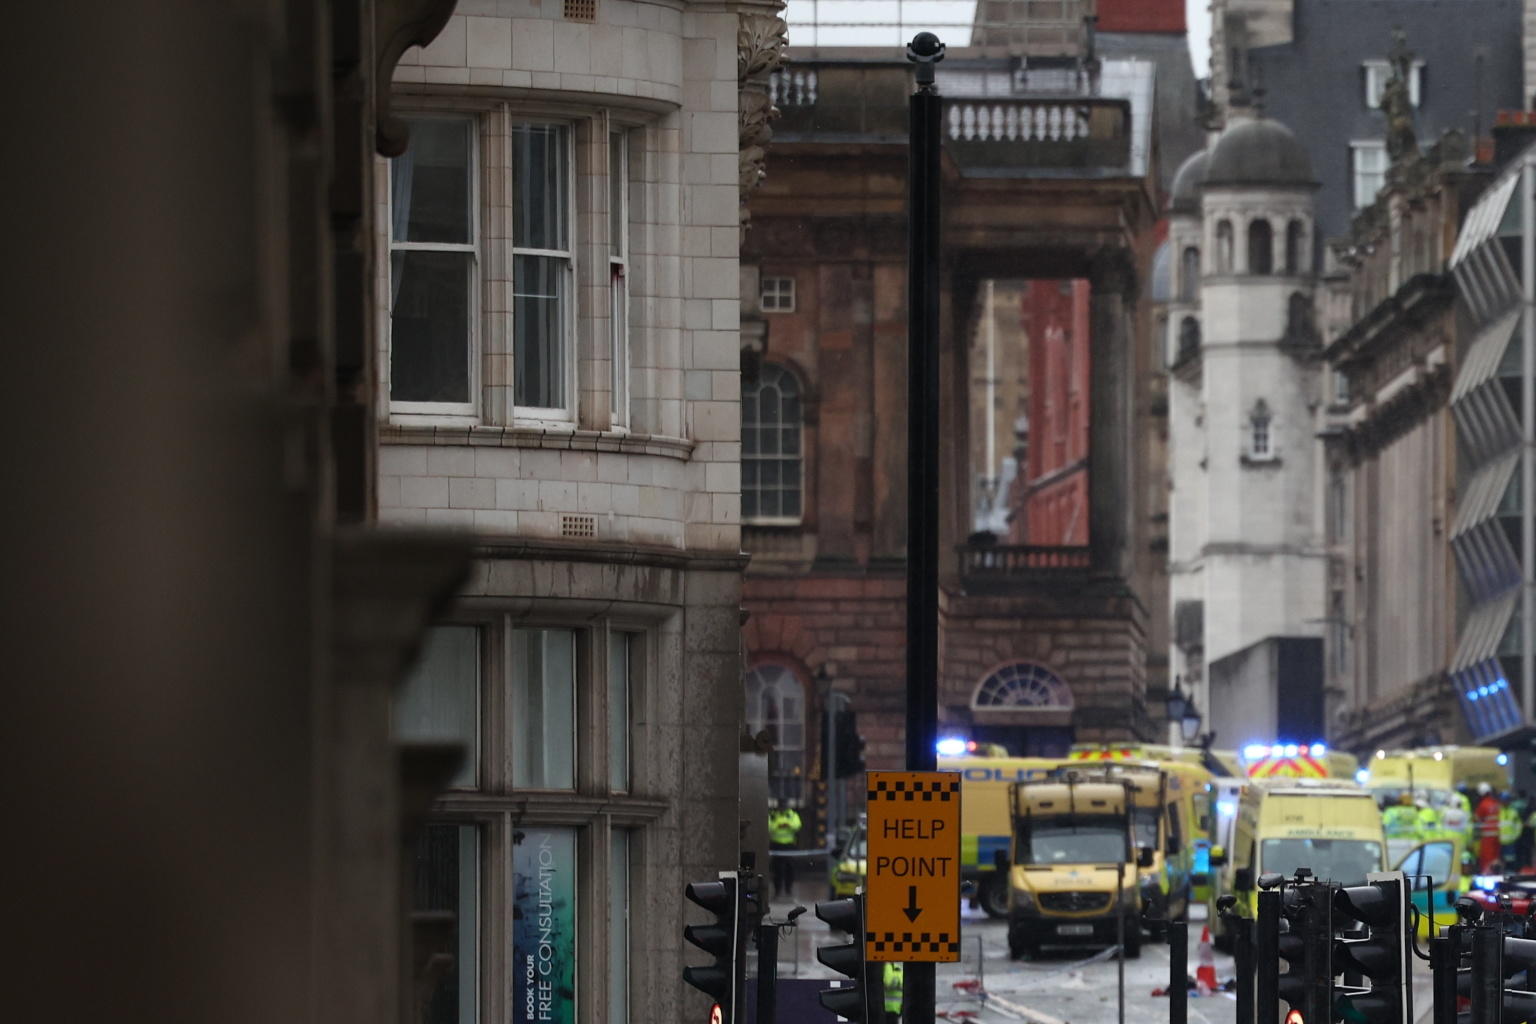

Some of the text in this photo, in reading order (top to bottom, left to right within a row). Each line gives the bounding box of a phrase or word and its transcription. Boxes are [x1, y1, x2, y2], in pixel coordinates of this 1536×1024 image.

[882, 819, 945, 839] HELP
[876, 857, 951, 877] POINT
[538, 833, 552, 1021] FREE CONSULTATION
[526, 954, 535, 1021] BOOK YOUR
